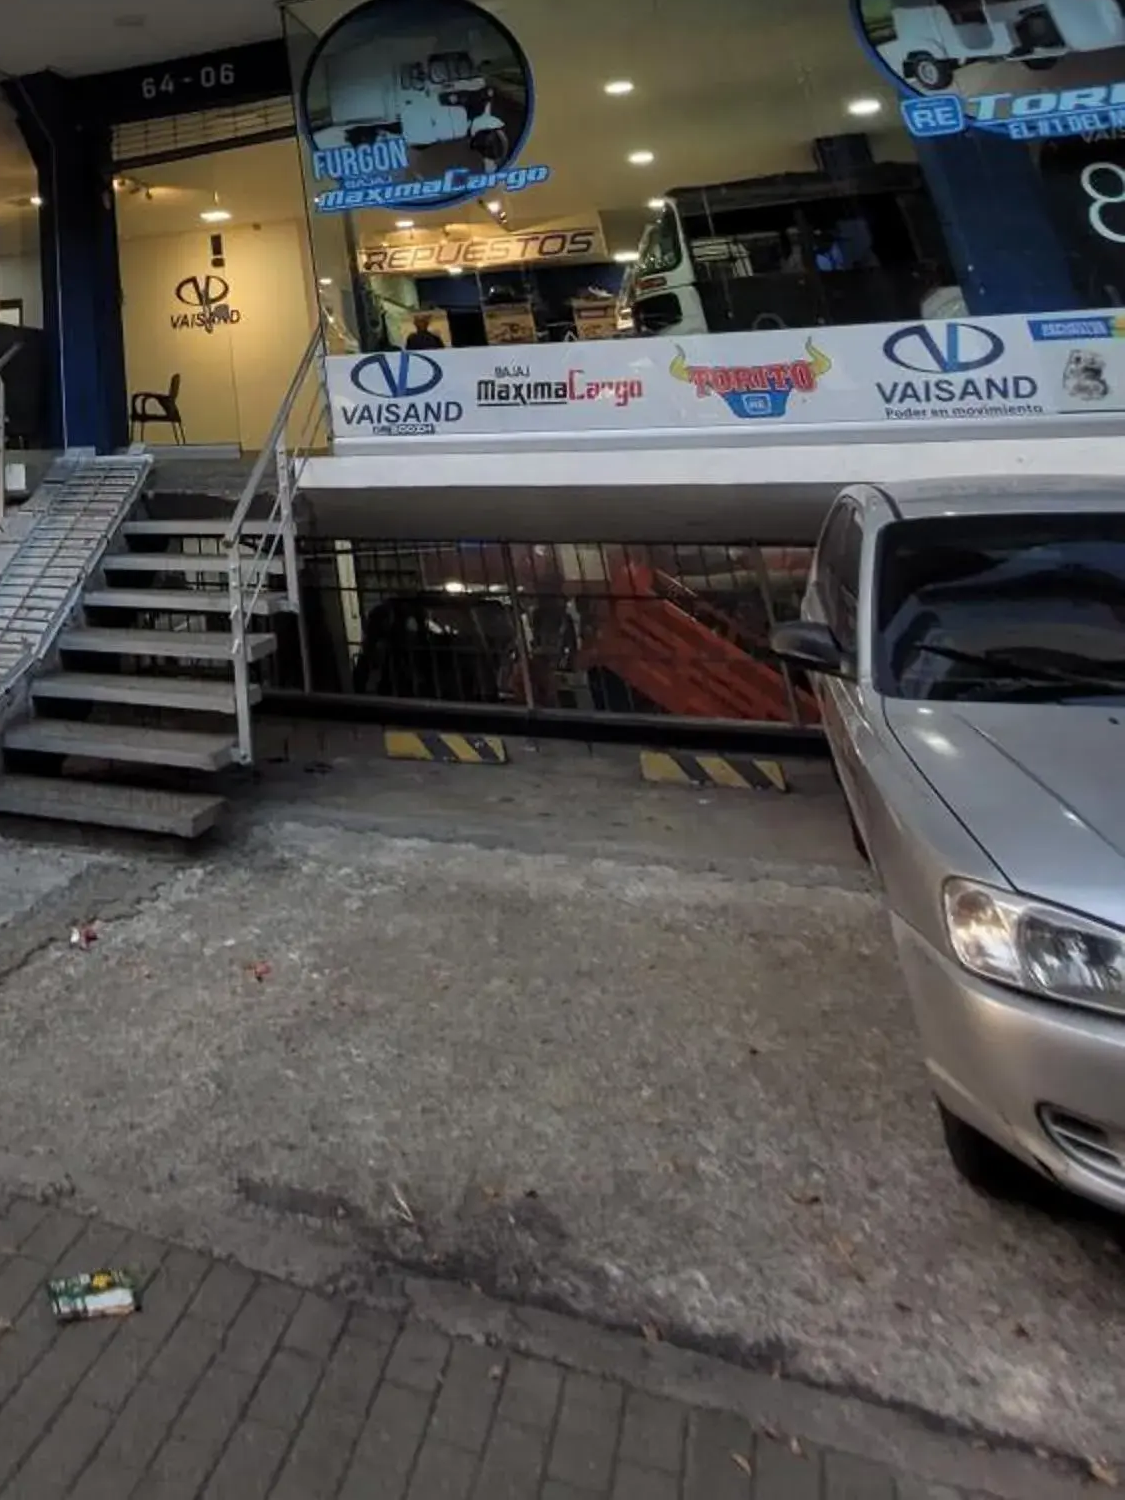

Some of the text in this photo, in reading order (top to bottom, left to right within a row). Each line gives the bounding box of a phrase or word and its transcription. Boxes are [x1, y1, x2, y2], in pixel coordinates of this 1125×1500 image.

[911, 105, 956, 129] RE
[1008, 120, 1036, 139] EL
[1066, 112, 1107, 132] DEL
[365, 231, 594, 270] REPUESTOS
[495, 366, 531, 378] BAJAJ
[688, 360, 818, 398] TORITO
[875, 375, 1038, 404] VAISAND
[341, 401, 463, 425] VAISAND
[885, 404, 1044, 420] Poder en movimiento
